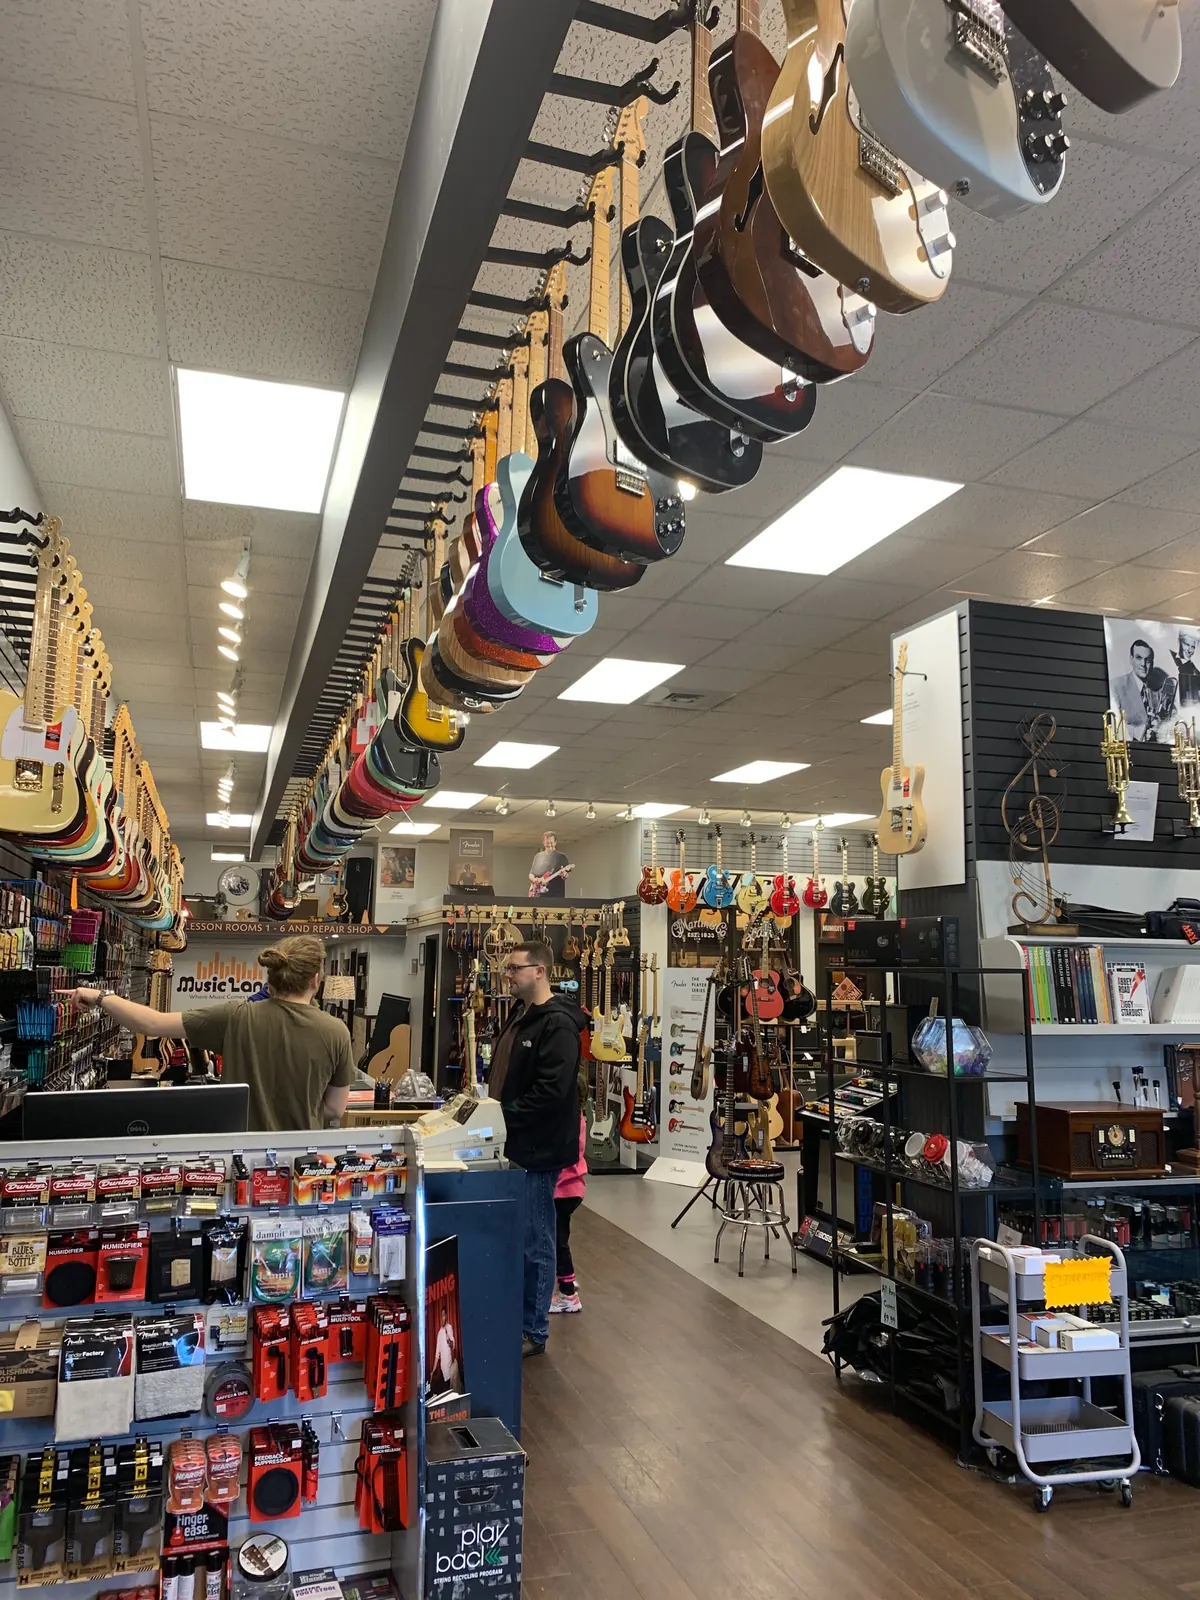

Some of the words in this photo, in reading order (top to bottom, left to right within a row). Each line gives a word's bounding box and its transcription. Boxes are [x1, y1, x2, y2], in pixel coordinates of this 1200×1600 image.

[185, 922, 223, 931] LESSON
[225, 923, 262, 932] ROOMS
[266, 924, 270, 932] 1
[280, 924, 285, 932] 6
[288, 925, 310, 933] AND
[312, 925, 345, 933] REPAIR
[347, 926, 373, 934] SHOP
[177, 976, 227, 992] Music
[228, 977, 263, 992] Lan
[303, 1168, 333, 1177] Energizer
[343, 1164, 372, 1173] Energizer
[146, 1174, 179, 1182] Dunlop
[188, 1174, 222, 1182] Dunlop
[8, 1182, 46, 1191] Dunlop
[55, 1181, 92, 1189] Dunlop
[101, 1179, 137, 1187] Dunlop
[256, 1231, 285, 1239] dampit
[12, 1246, 34, 1255] BLUES
[101, 1242, 143, 1250] HUMIDIFIER
[48, 1247, 84, 1256] HUMIDIFIER
[8, 1257, 36, 1267] BOTTLE
[256, 1272, 293, 1280] dmpit
[137, 1330, 159, 1340] Fender
[64, 1337, 85, 1346] Fender
[429, 1408, 445, 1420] THE
[254, 1452, 284, 1461] FEEDBACK
[254, 1457, 291, 1466] SUPPRESSOR
[461, 1523, 509, 1551] play
[434, 1576, 451, 1584] STRING
[452, 1572, 478, 1581] RECYCLING
[480, 1568, 503, 1577] PROGRAM
